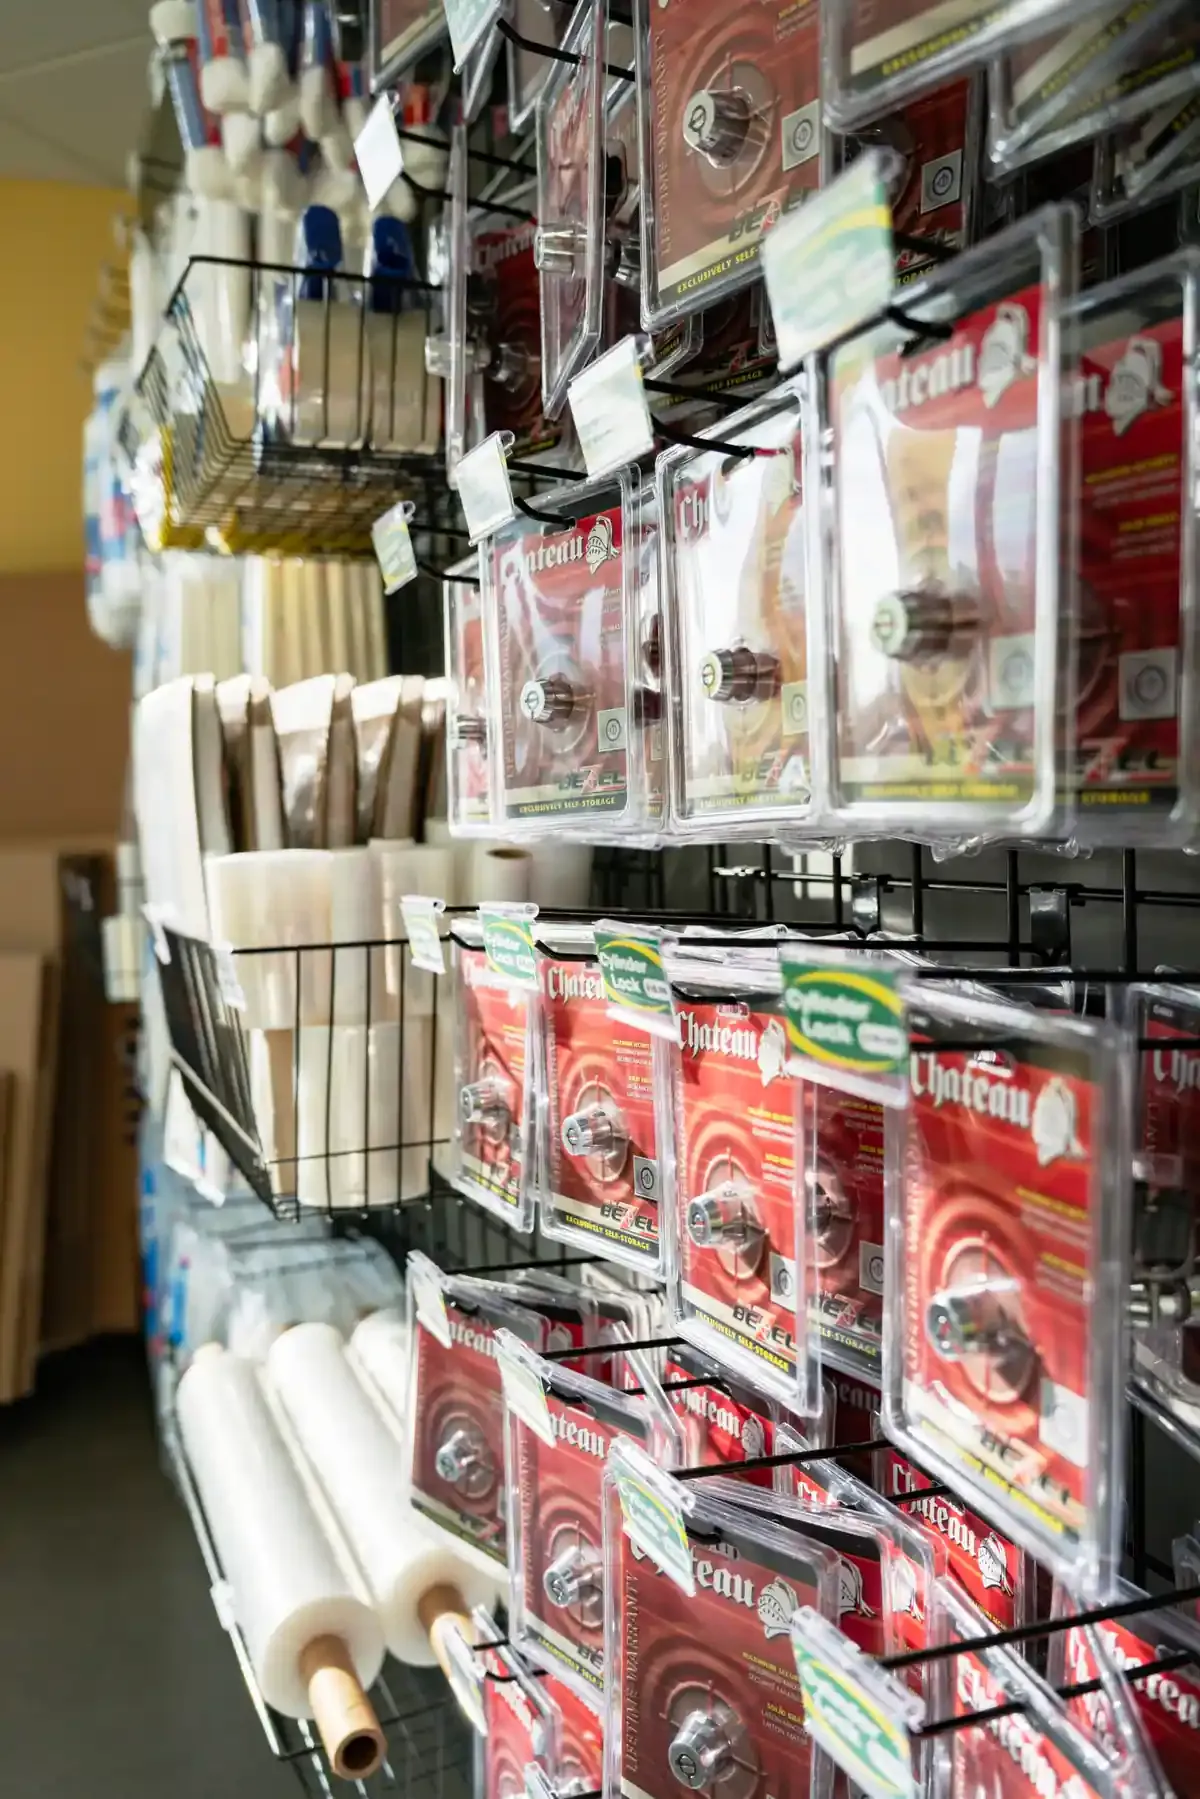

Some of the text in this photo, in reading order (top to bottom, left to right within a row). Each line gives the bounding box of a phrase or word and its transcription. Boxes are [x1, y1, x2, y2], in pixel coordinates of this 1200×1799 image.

[677, 259, 732, 294] EXCLUSIVELY
[600, 951, 648, 974] Cylinder
[611, 973, 642, 994] Lock
[673, 1010, 758, 1060] Chateau
[909, 1050, 1030, 1128] Chateau
[600, 1200, 660, 1233] BEZEL
[604, 1228, 650, 1251] SELF-STORAGE
[733, 1303, 798, 1352] BEZEL
[624, 1569, 640, 1773] LIFETIME WARRANTY
